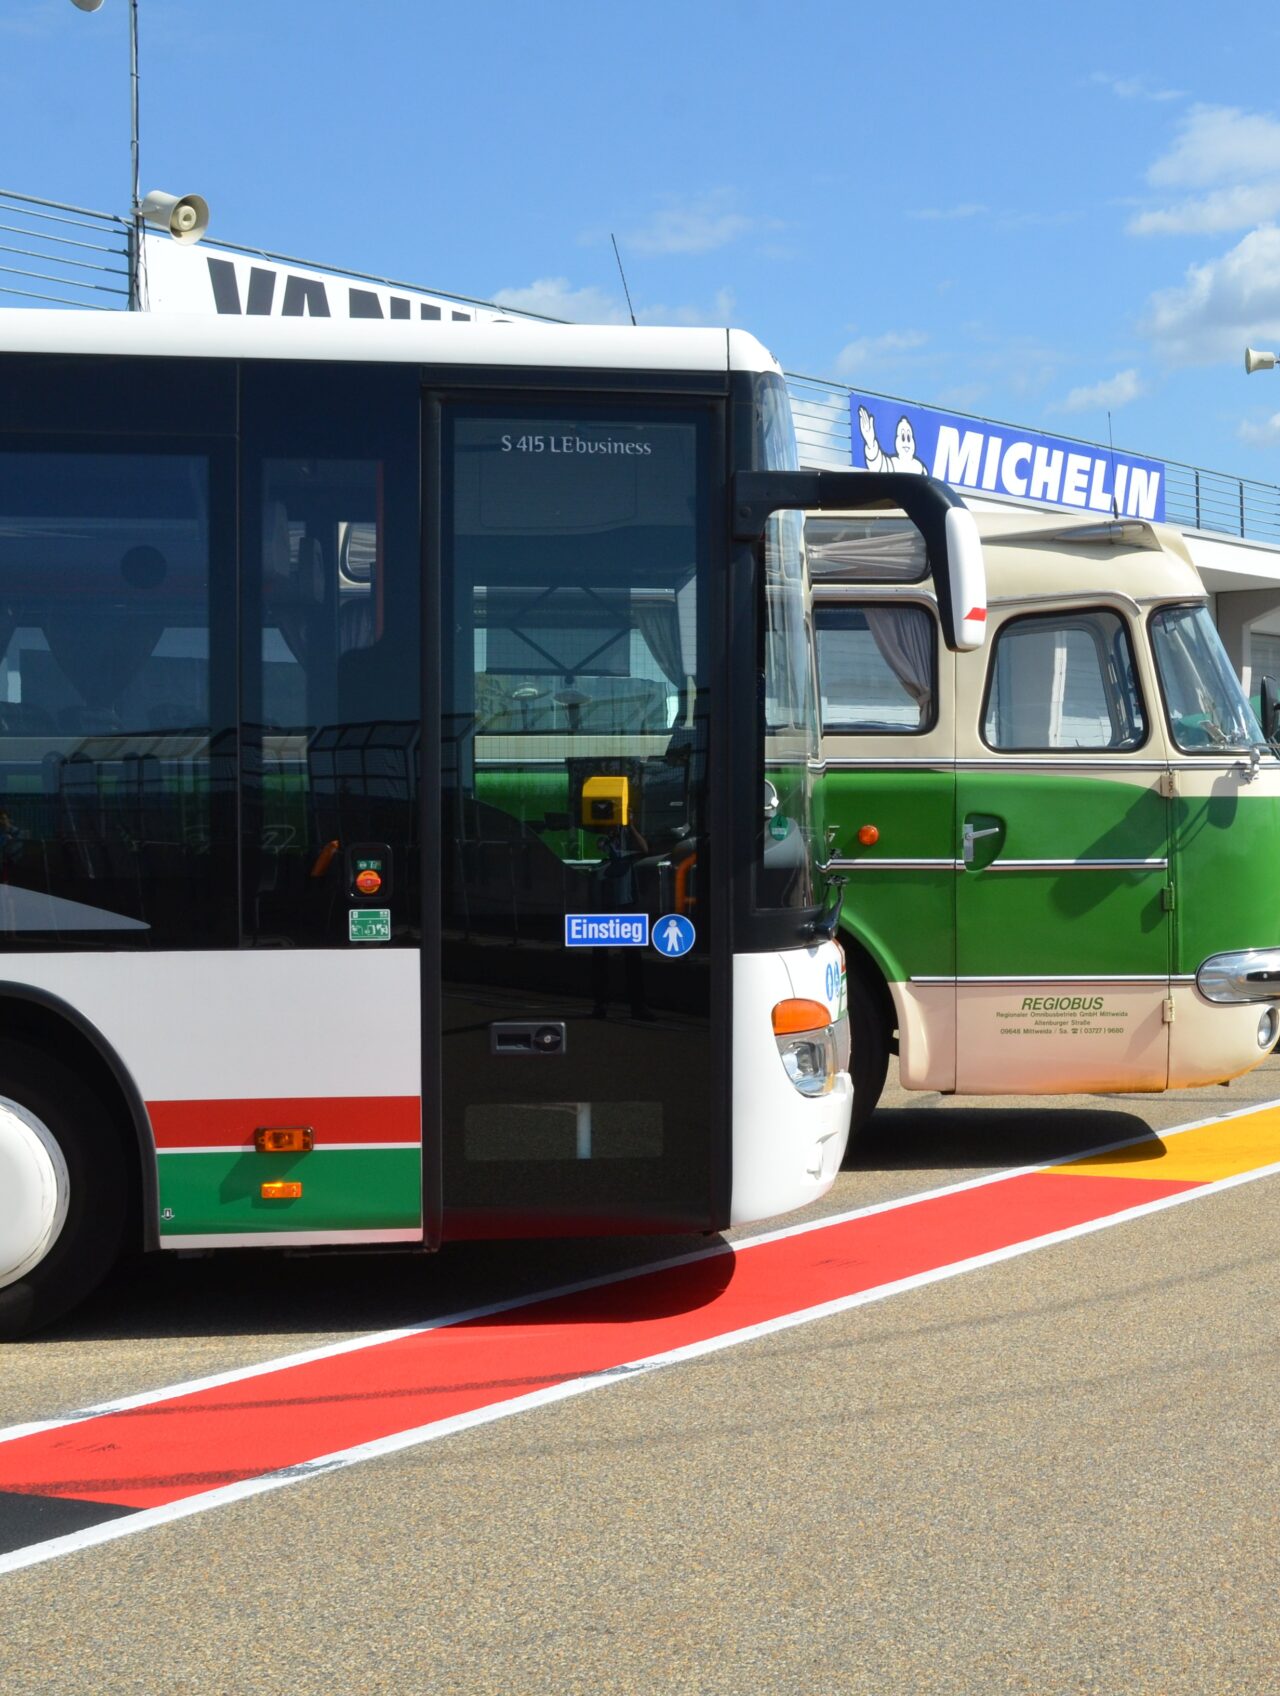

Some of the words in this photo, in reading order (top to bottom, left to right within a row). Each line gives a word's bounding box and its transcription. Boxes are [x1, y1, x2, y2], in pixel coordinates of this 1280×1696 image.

[501, 434, 513, 452] S
[515, 435, 545, 453] 415
[931, 424, 1161, 520] MICHELIN
[570, 918, 643, 943] Einstieg
[1021, 996, 1105, 1011] REGIOBUS
[995, 1011, 1028, 1019] Regionaler
[1099, 1010, 1129, 1018] Mittweida
